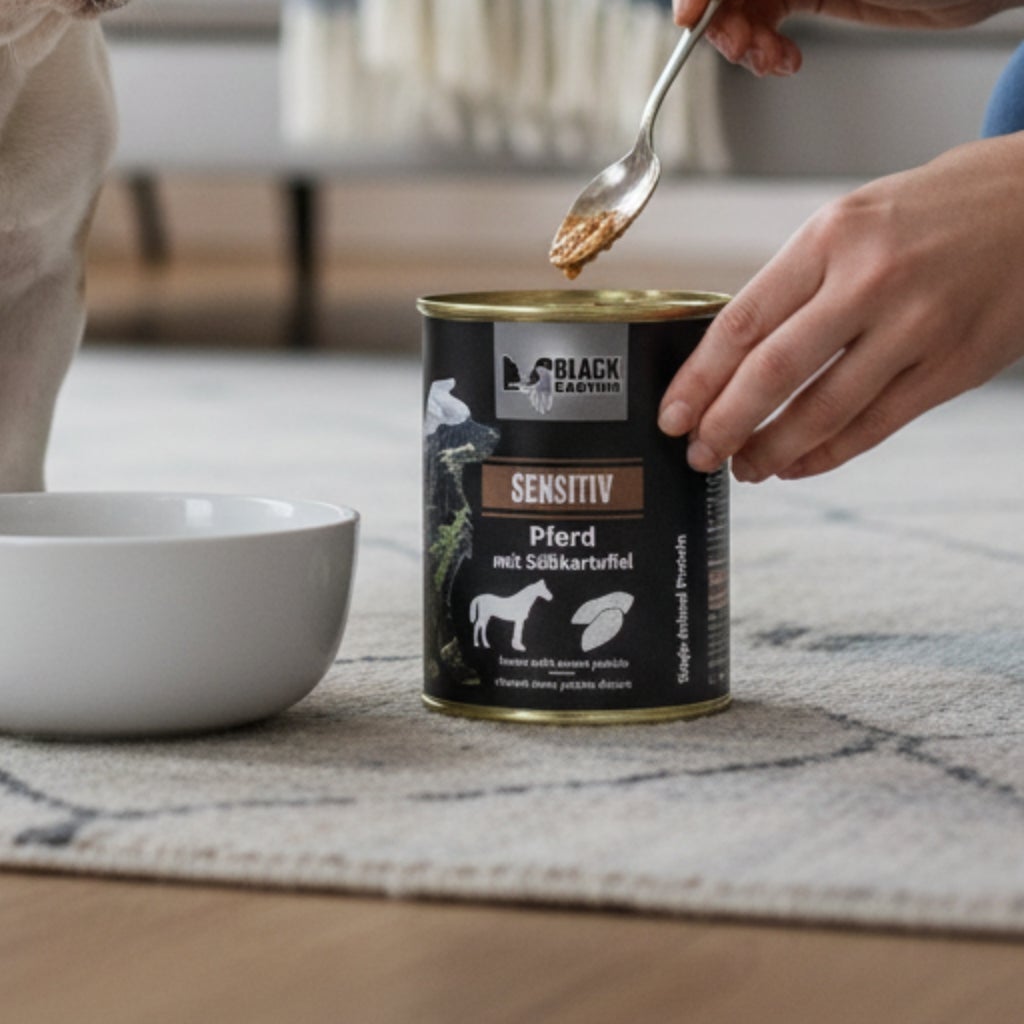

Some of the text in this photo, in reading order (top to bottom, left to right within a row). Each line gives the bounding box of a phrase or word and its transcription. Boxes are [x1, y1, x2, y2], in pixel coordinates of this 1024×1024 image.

[554, 357, 620, 380] BLACK
[511, 472, 614, 504] SENSITIV
[529, 525, 596, 547] Pferd
